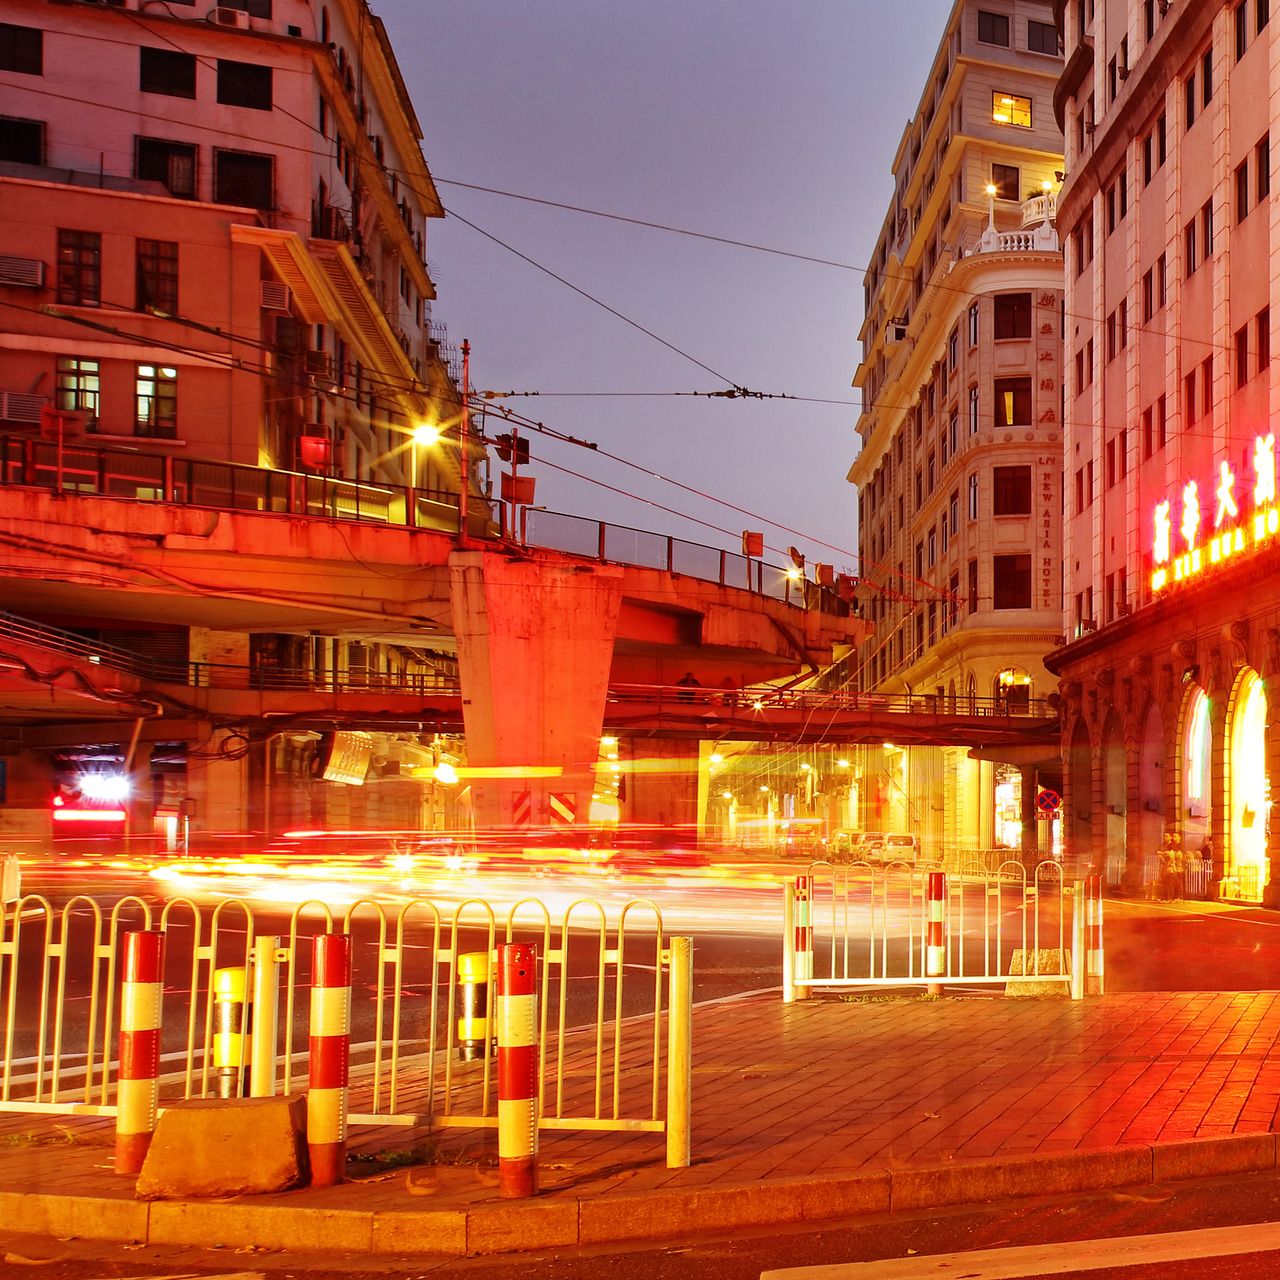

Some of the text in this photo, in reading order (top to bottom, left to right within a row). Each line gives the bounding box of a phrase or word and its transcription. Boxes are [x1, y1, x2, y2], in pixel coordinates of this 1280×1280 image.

[1042, 473, 1052, 502] NEW
[1042, 509, 1052, 549] ASIA
[1042, 558, 1052, 608] HOTEL
